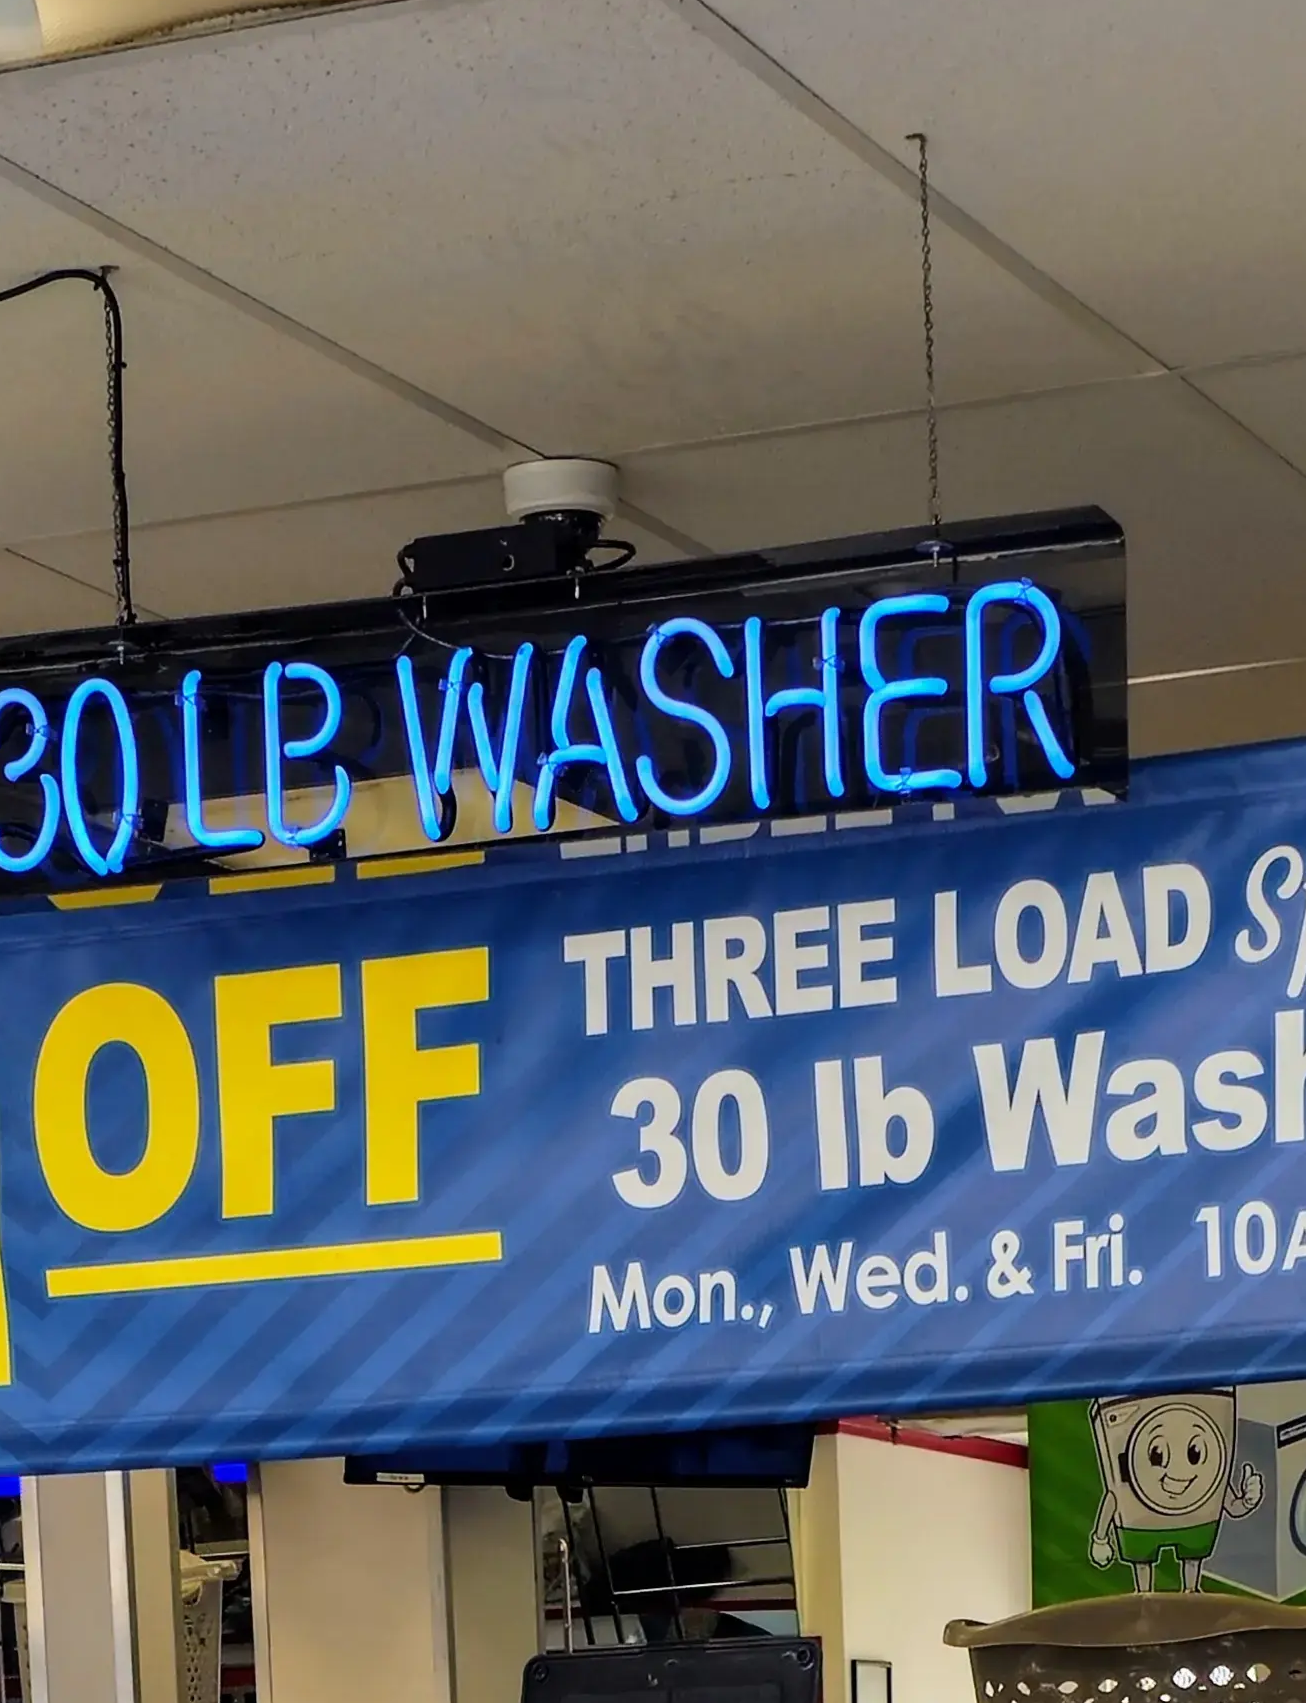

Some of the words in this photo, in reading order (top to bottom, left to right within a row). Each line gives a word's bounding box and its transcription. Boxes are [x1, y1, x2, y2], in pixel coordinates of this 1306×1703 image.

[183, 660, 352, 852] LB
[396, 578, 1074, 843] WASHER
[564, 901, 897, 1038] THREE
[933, 863, 1214, 997] LOAD
[34, 945, 492, 1234] OFF
[609, 1071, 769, 1210] 30
[816, 1052, 935, 1193] lb
[586, 1260, 774, 1333] Mon.,
[790, 1240, 968, 1317] Wed.
[987, 1237, 1034, 1298] &
[1050, 1215, 1143, 1287] Fri.
